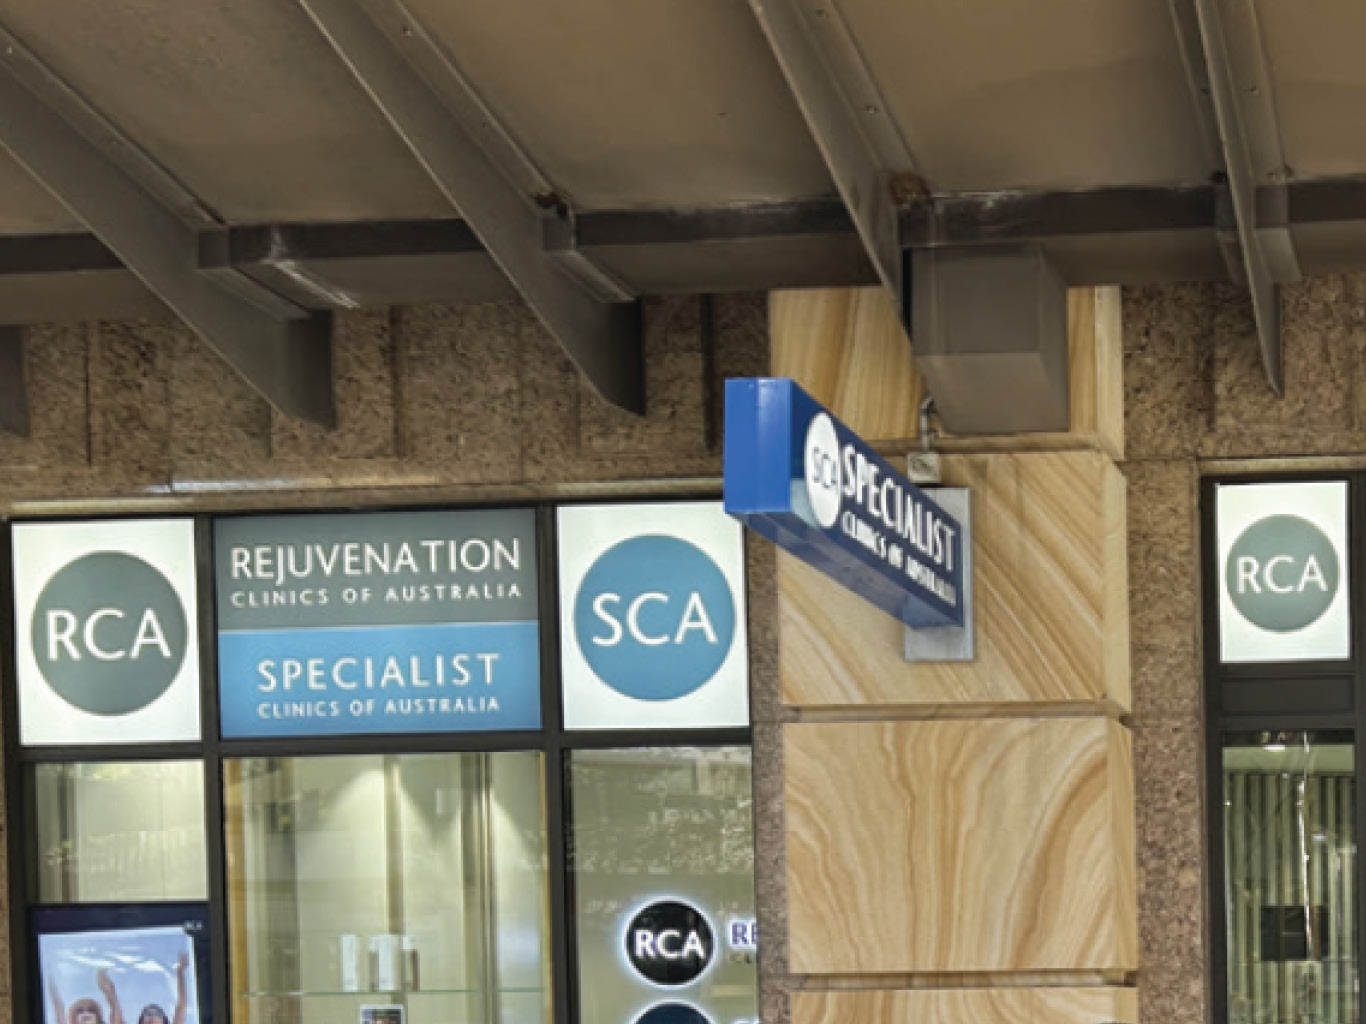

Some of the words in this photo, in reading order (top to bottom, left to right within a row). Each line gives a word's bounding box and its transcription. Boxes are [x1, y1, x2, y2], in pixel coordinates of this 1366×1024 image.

[842, 443, 956, 573] SPECIALIST
[230, 537, 520, 587] REJUVENATION
[1235, 556, 1329, 596] RCA
[230, 587, 330, 608] CLINICS
[342, 586, 373, 604] OF
[384, 583, 523, 601] AUSTRALIA
[46, 608, 173, 663] RCA
[591, 590, 719, 647] SCA
[256, 652, 500, 693] SPECIALIST
[256, 700, 341, 719] CLINICS
[349, 698, 374, 717] OF
[384, 696, 500, 715] AUSTRALIA
[633, 929, 705, 959] RCA
